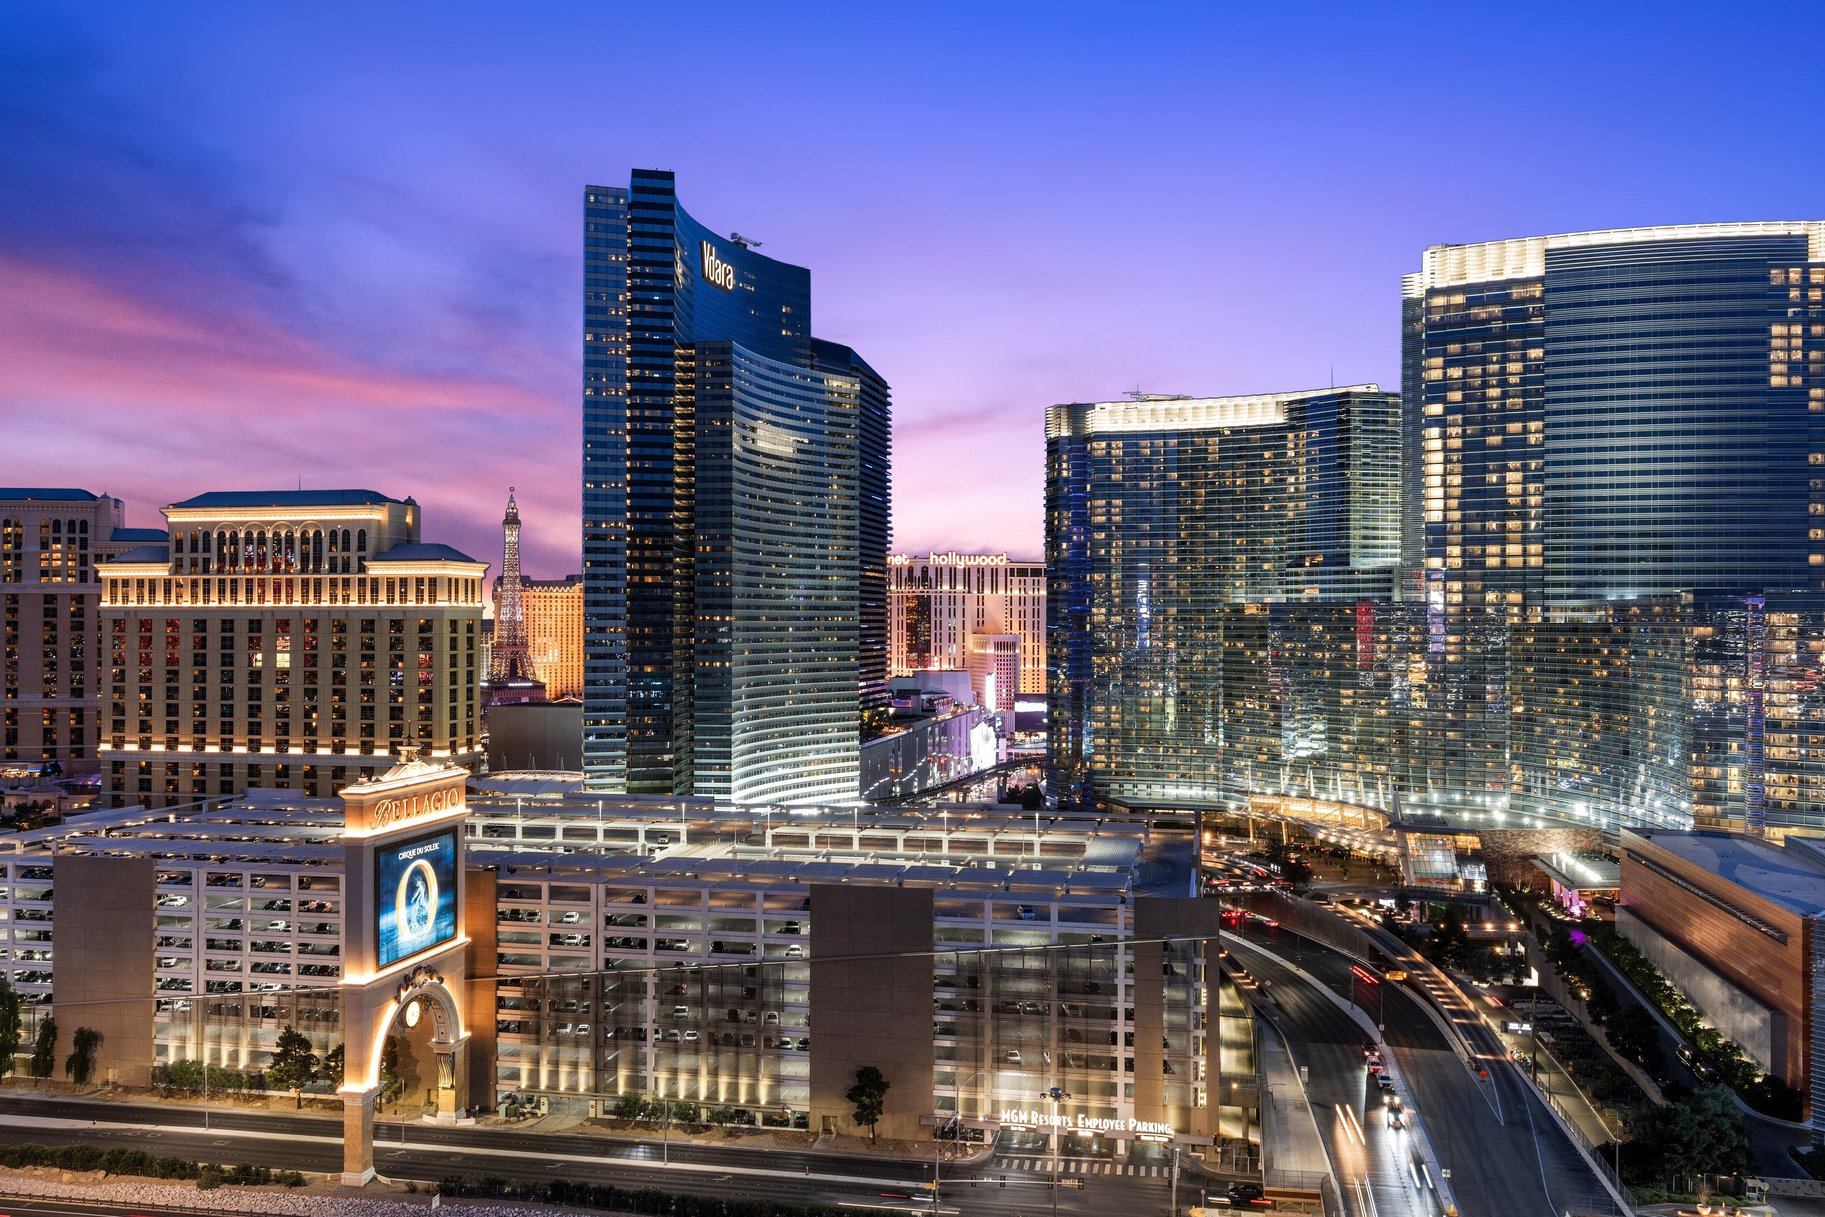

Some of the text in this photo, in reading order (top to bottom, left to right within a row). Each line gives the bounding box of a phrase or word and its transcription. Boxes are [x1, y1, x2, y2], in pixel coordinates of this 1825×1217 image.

[703, 240, 734, 290] Vdara
[929, 551, 1007, 569] hollywood
[369, 787, 460, 830] BELLAGIO
[398, 848, 417, 860] CIRQUE
[1001, 1109, 1172, 1134] MGM RESORTS EMPLOYEE PARKING
